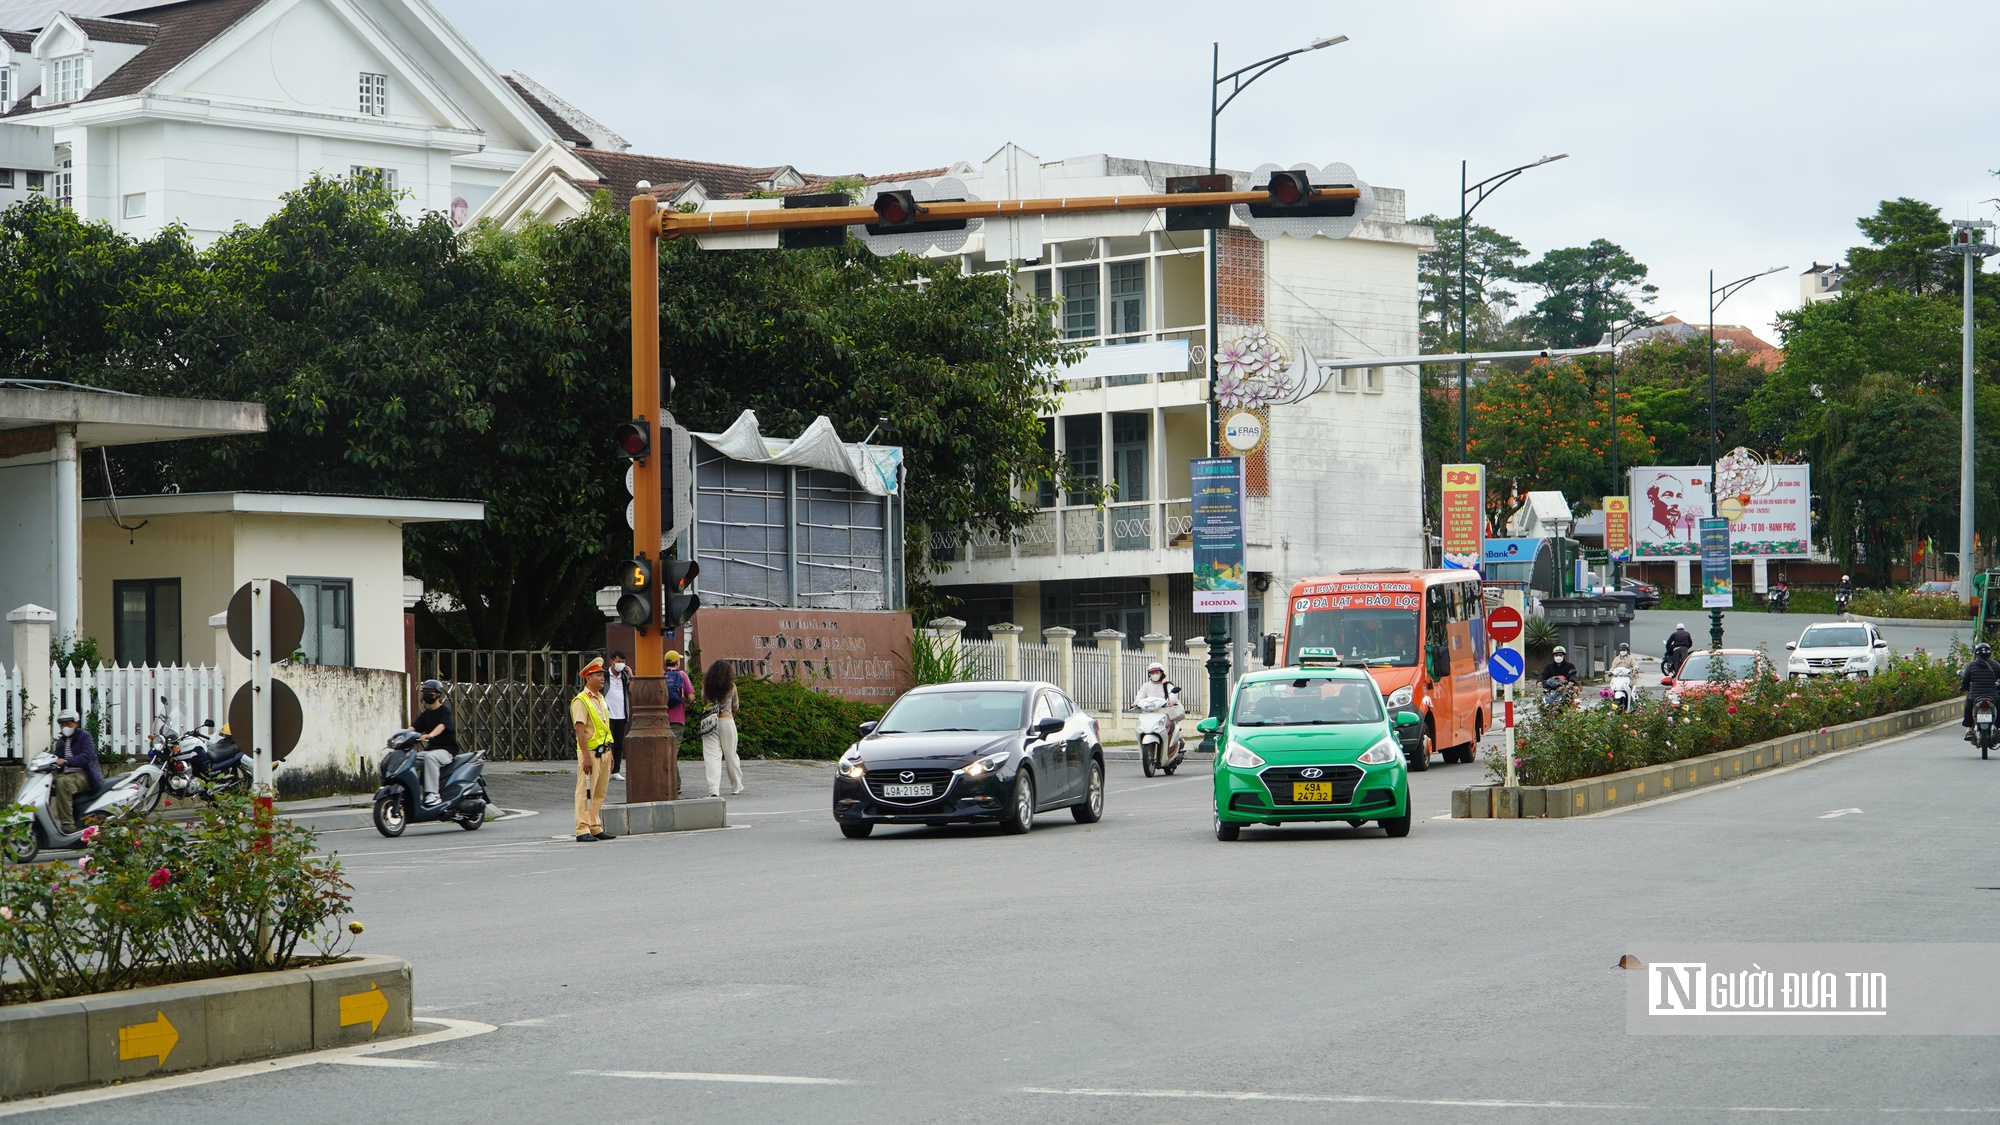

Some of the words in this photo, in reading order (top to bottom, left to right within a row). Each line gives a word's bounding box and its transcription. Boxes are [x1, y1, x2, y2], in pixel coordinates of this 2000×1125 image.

[1238, 426, 1260, 434] ERAS
[1220, 465, 1234, 475] MẠC
[1737, 522, 1746, 534] LẬP
[1758, 523, 1765, 532] DO
[1769, 523, 1782, 534] HẠNH
[1783, 521, 1796, 532] PHÚC
[635, 567, 645, 585] 5
[1342, 582, 1380, 592] PHƯƠNG
[1381, 583, 1411, 591] TRANG
[1297, 600, 1308, 610] 02
[1313, 596, 1328, 608] ĐÀ
[1332, 597, 1352, 609] LẠT
[1366, 593, 1392, 606] BẢO
[1395, 595, 1420, 609] LỘC
[805, 637, 830, 650] CAO
[725, 658, 754, 676] INH
[1304, 783, 1321, 791] 49A
[1298, 792, 1328, 801] 247.32
